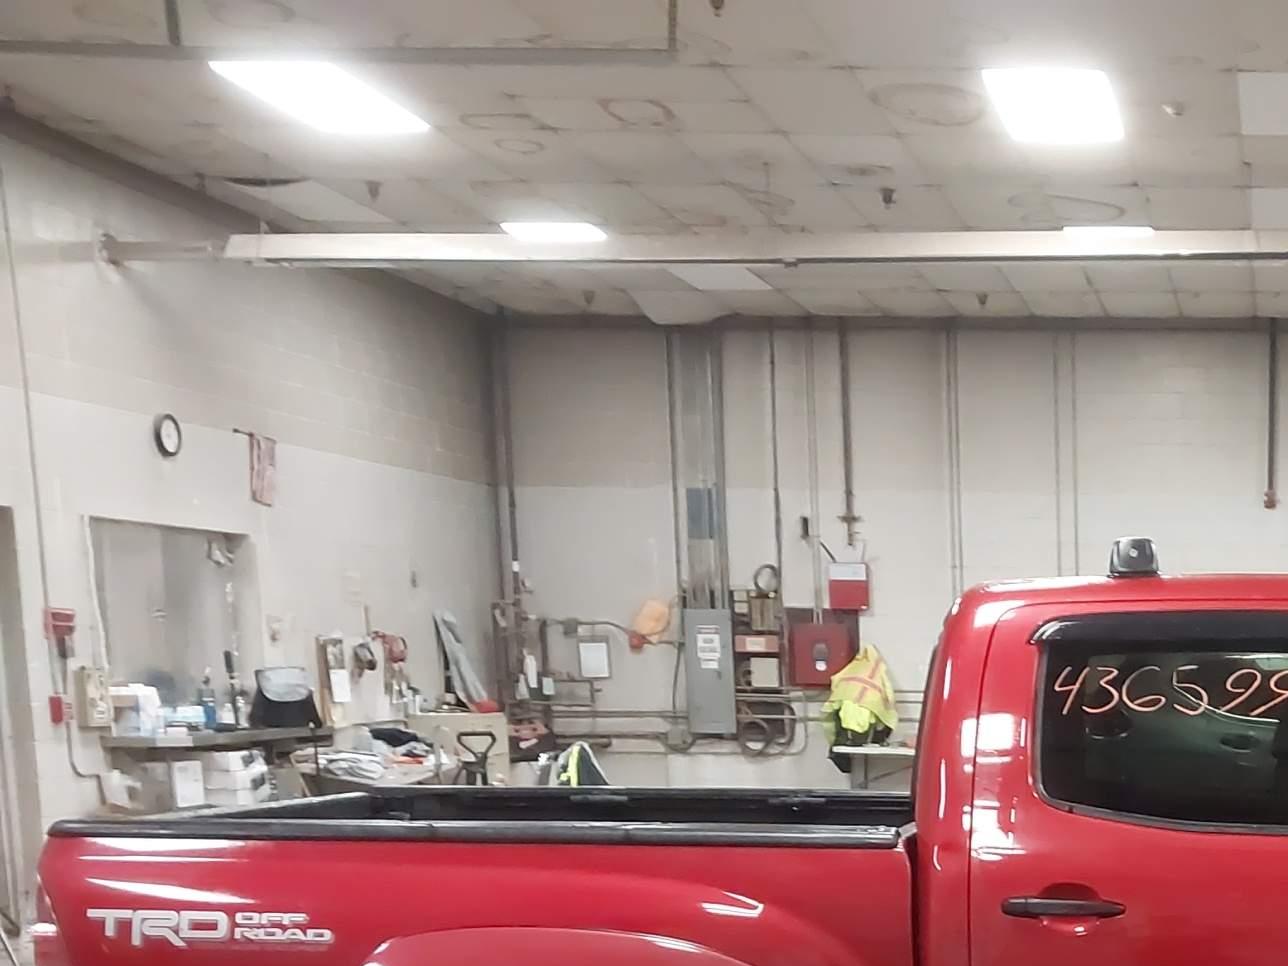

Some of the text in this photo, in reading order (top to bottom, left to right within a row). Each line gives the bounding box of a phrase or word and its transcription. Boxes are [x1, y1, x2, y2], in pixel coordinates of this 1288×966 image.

[234, 912, 310, 925] OFF
[86, 908, 229, 947] TRD
[233, 927, 334, 942] ROAD
